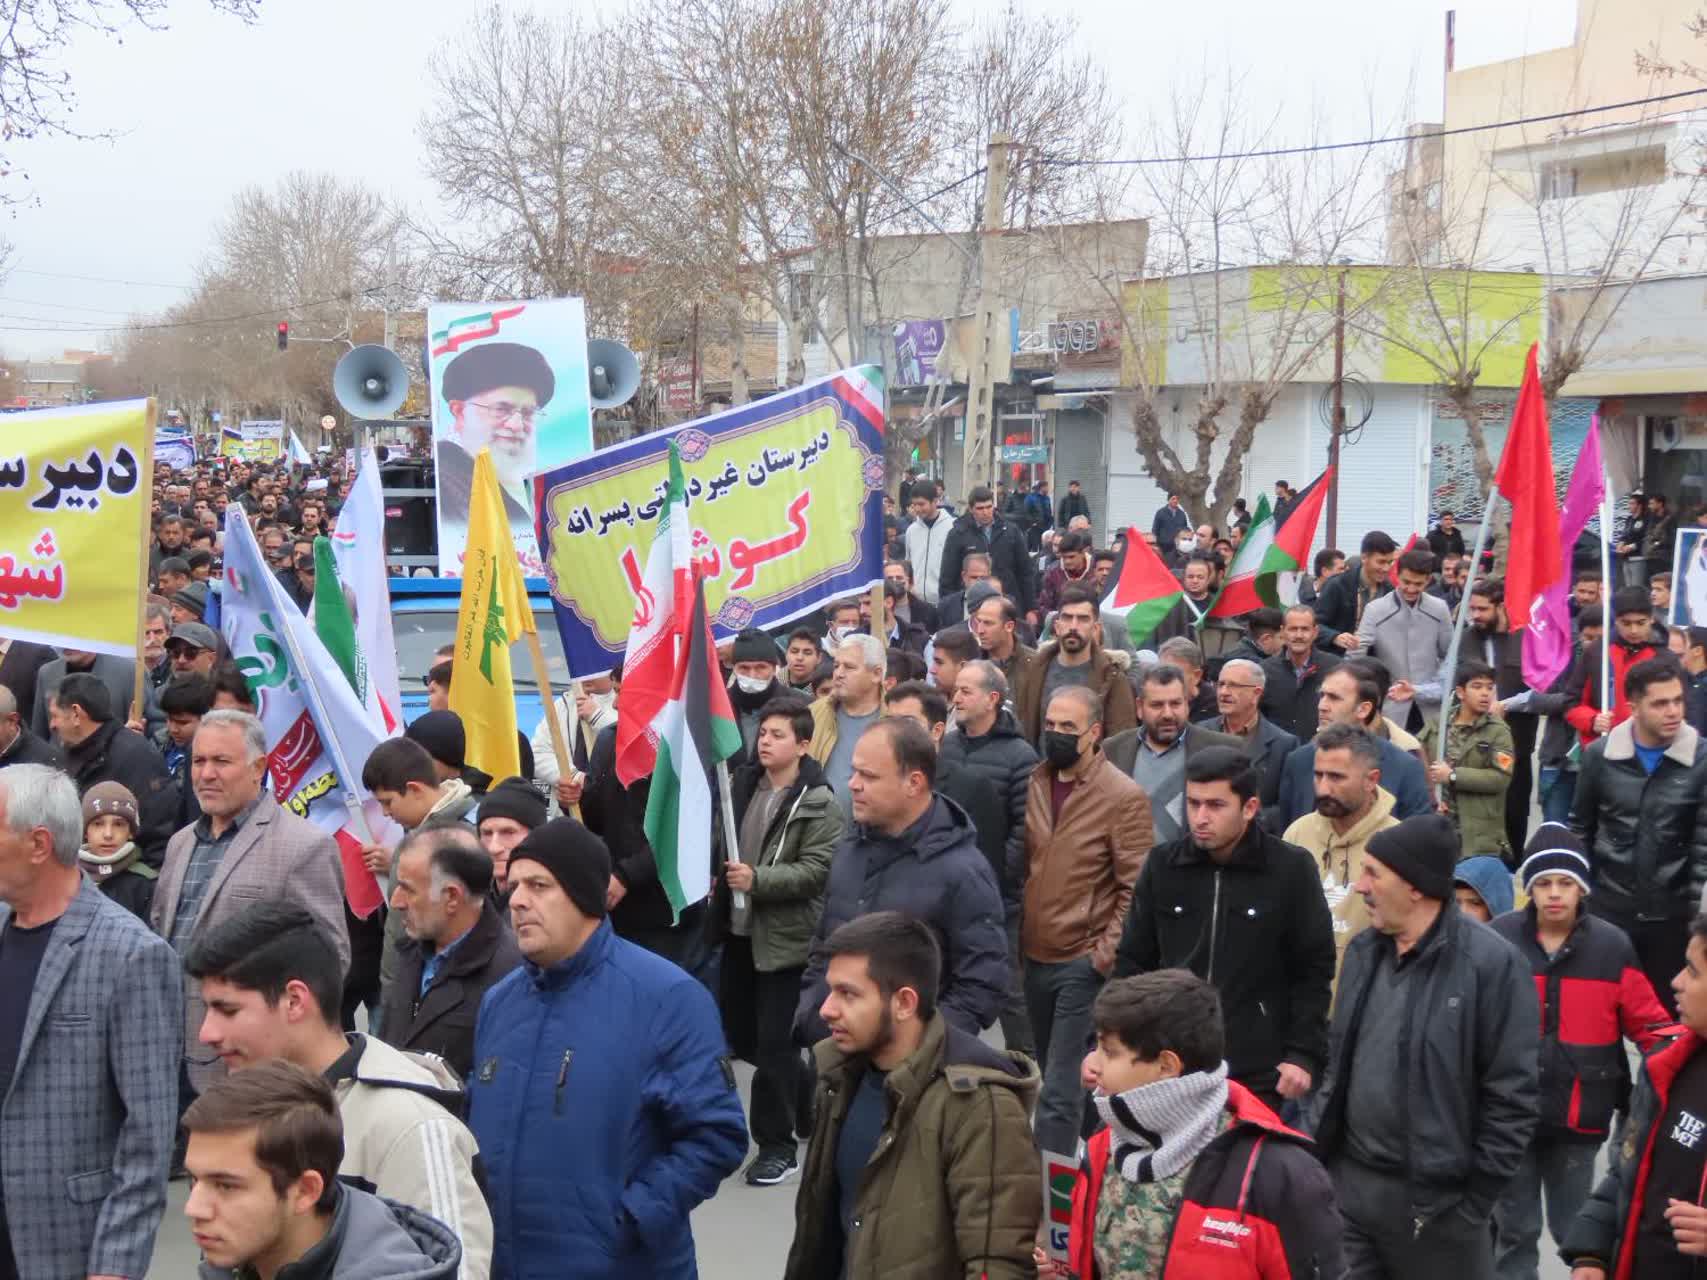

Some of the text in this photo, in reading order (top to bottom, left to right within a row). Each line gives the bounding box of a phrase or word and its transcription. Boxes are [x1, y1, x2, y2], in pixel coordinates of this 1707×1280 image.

[747, 431, 829, 486] دبیرستان
[567, 501, 634, 535] پسرانه
[1679, 1110, 1706, 1138] THE
